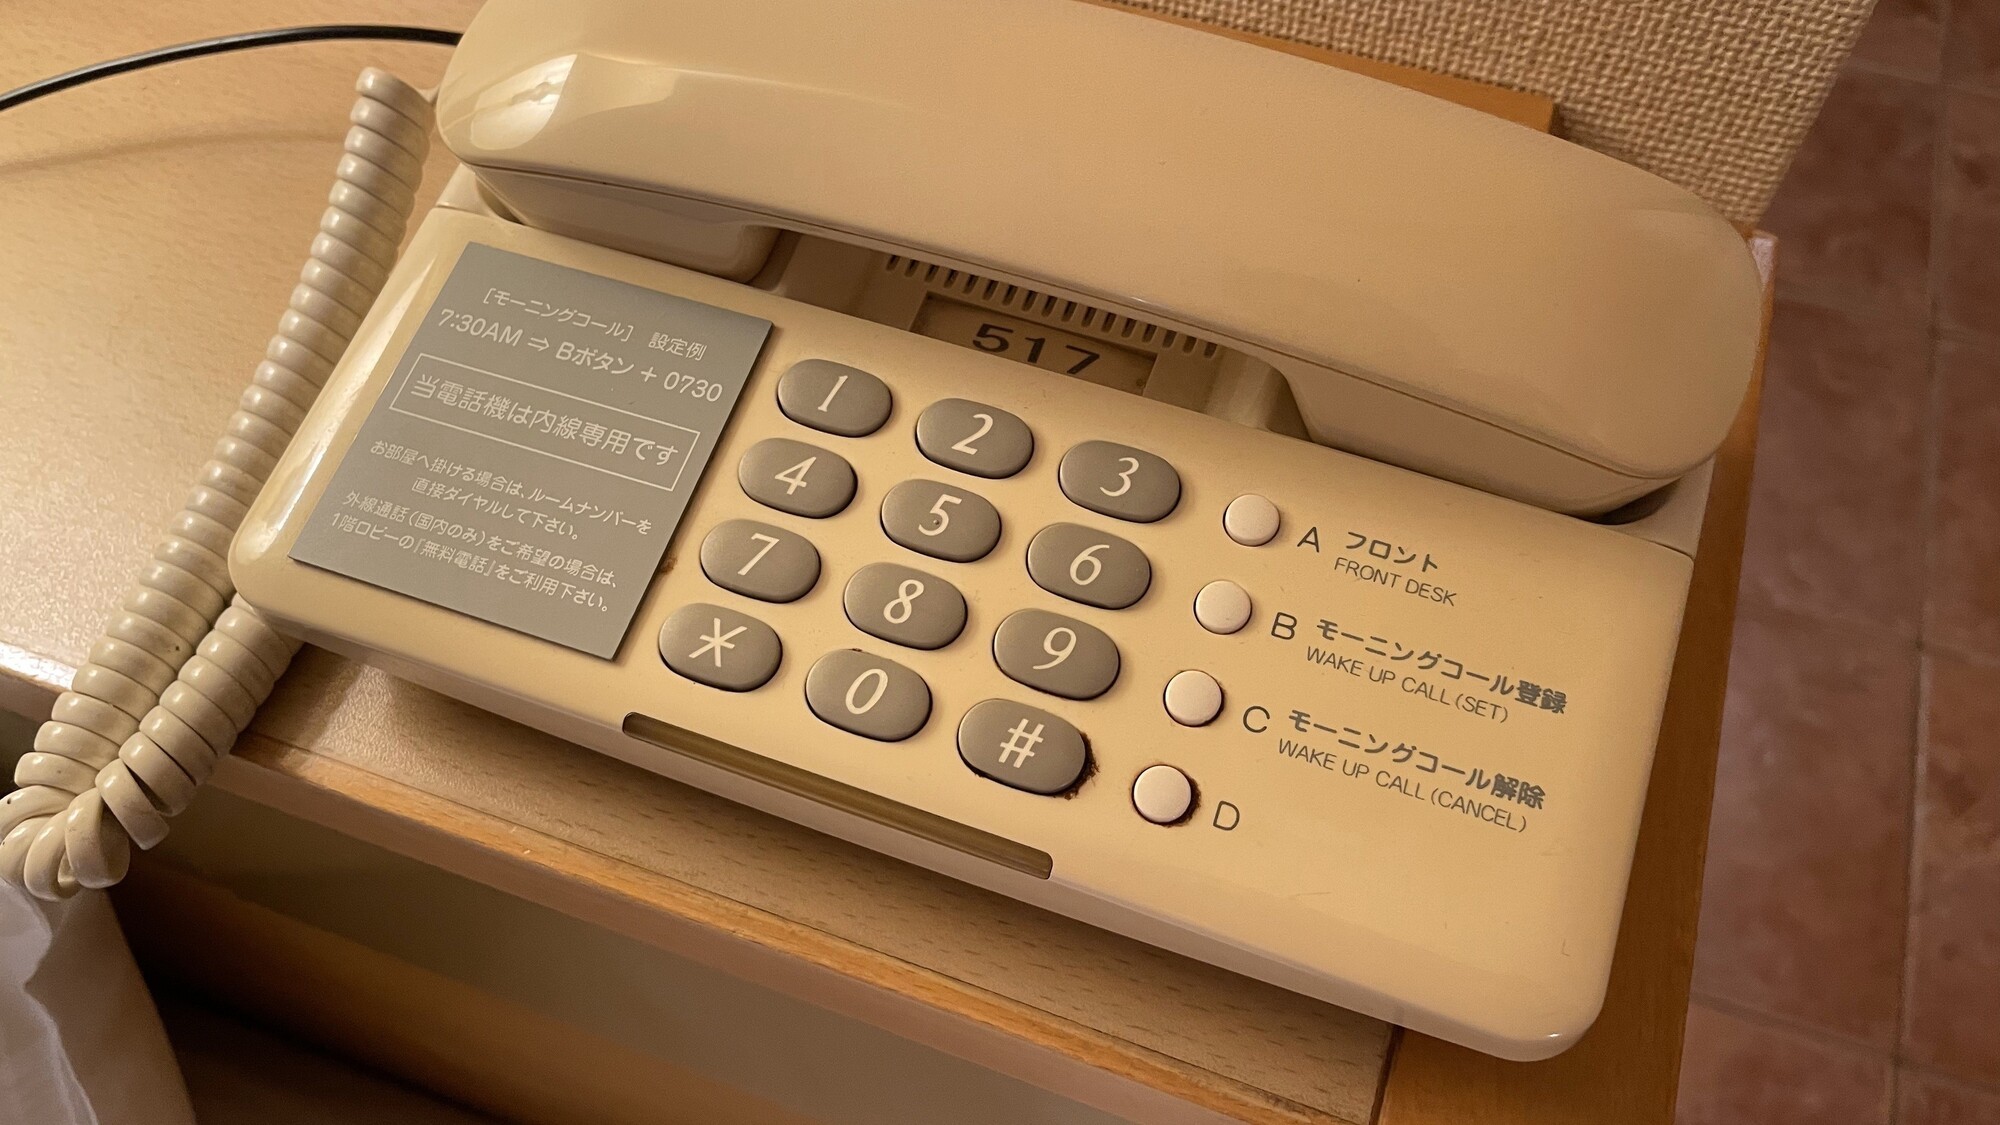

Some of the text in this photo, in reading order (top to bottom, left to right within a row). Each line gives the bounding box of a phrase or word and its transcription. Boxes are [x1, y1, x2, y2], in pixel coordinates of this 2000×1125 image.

[438, 308, 524, 348] 7:30AM
[555, 341, 635, 376] Bボタン
[663, 371, 723, 402] 0730
[648, 332, 708, 362] 設定例
[972, 322, 1101, 375] 517
[817, 375, 849, 413] 1
[410, 373, 680, 466] 当電話機は内線専用です
[951, 413, 994, 456] 2
[775, 456, 817, 495] 4
[1099, 456, 1140, 498] 3
[411, 476, 579, 541] 直接ダイヤルして下さい。
[917, 493, 963, 537] 5
[737, 532, 780, 576] 7
[1069, 544, 1110, 586] 6
[1296, 526, 1438, 573] A フロント
[883, 579, 925, 625] 8
[1333, 556, 1457, 607] FRONT DESK
[1032, 626, 1077, 670] 9
[1270, 611, 1568, 715] B モーニングコール登録
[845, 668, 889, 715] 0
[1306, 645, 1509, 724] WAKE UP CALL (SET)
[998, 718, 1045, 769] #
[1242, 705, 1546, 810] C モーニングコール解除
[1277, 737, 1527, 833] WAKE UP CALL (CANCEL)
[1212, 800, 1241, 832] D
